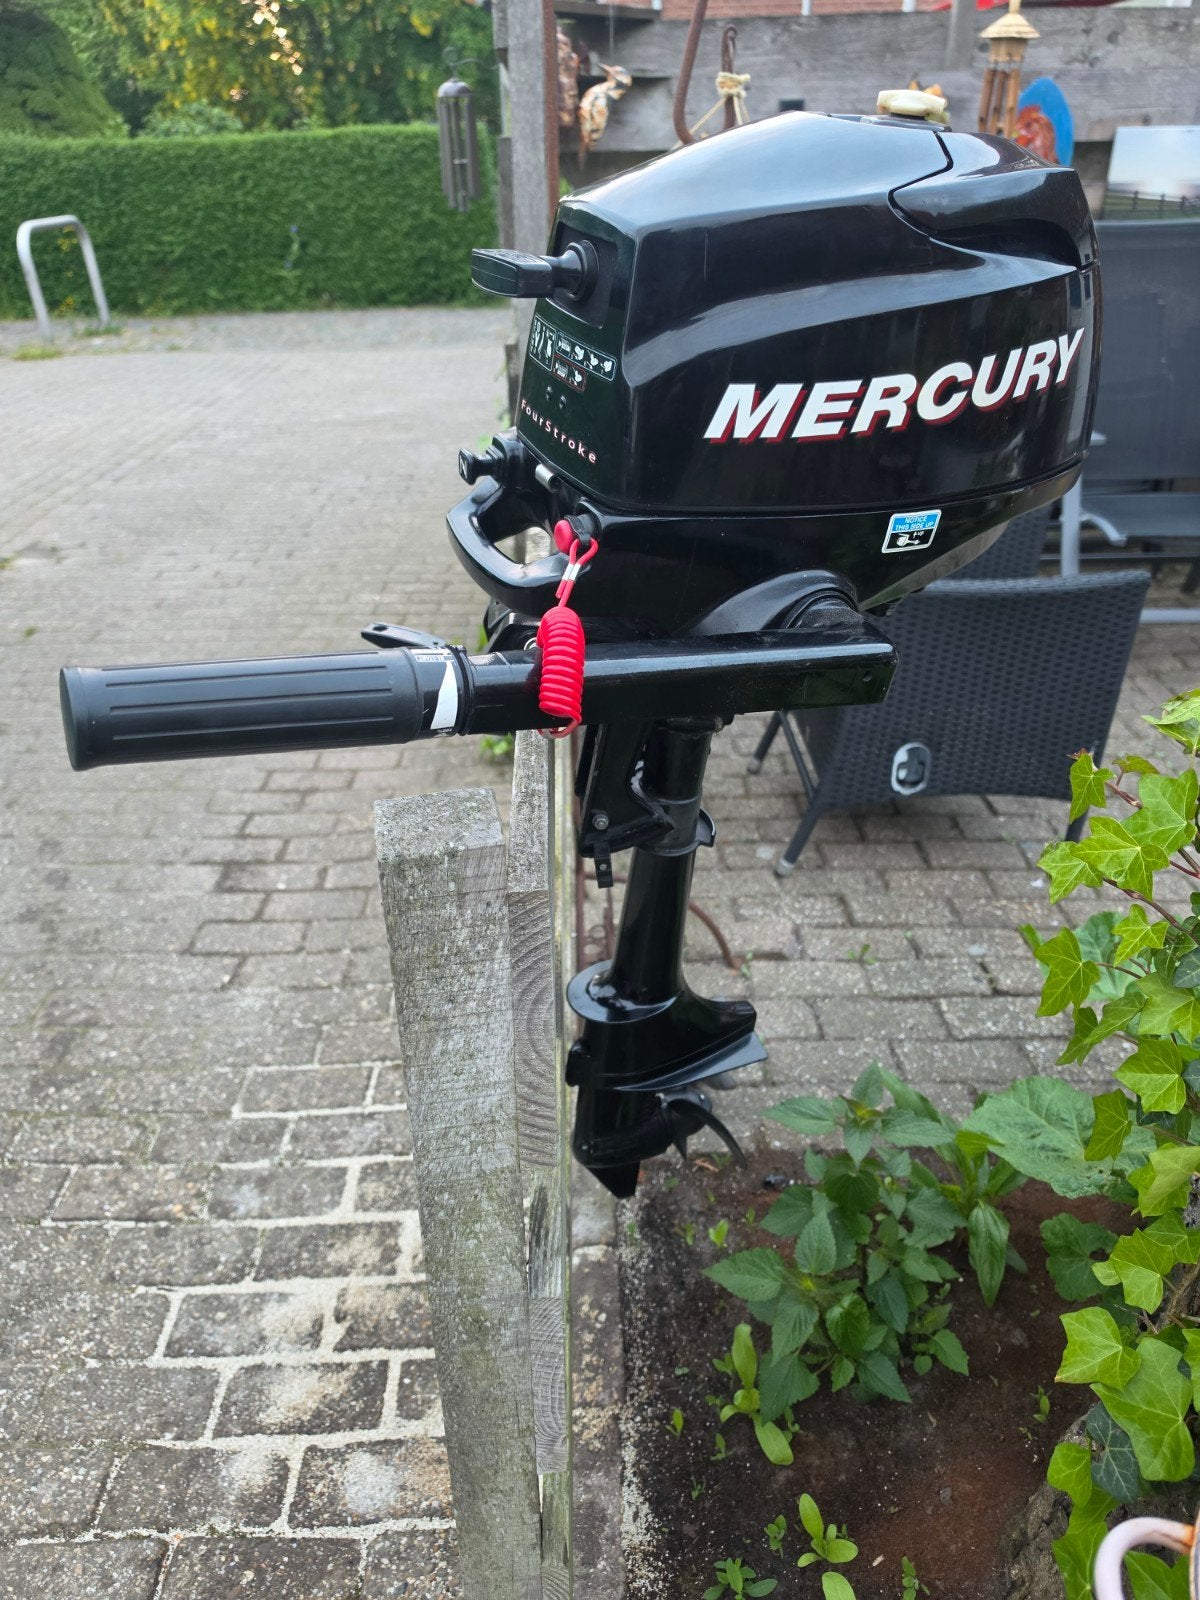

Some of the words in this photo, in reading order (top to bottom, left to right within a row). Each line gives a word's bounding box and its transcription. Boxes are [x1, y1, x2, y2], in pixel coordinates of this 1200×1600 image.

[702, 327, 1085, 443] MERCURY
[521, 399, 597, 464] FourStroke
[905, 515, 927, 524] NOTICE
[910, 522, 925, 530] SIDE
